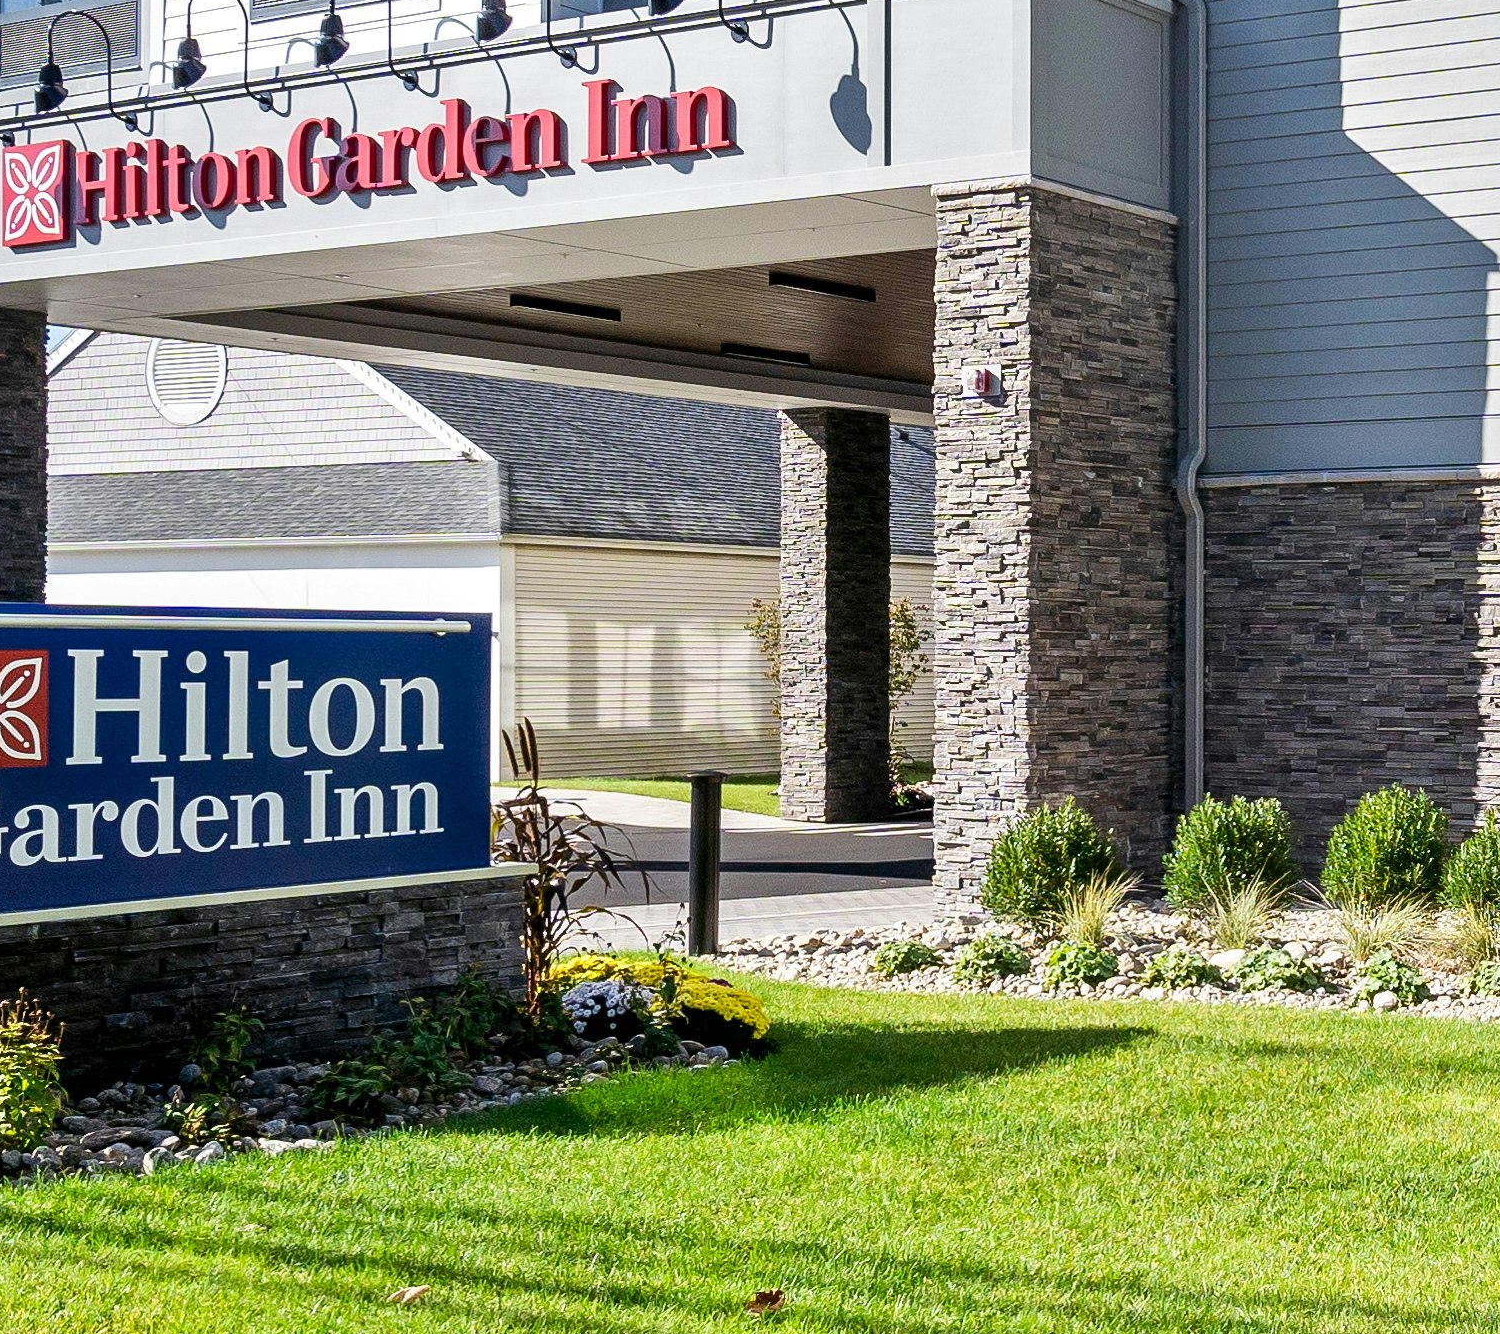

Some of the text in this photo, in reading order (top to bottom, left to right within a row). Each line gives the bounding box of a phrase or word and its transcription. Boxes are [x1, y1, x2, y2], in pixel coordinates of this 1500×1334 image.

[73, 79, 731, 226] Hilton Garden Inn
[65, 648, 445, 766] Hilton
[303, 769, 445, 844] Inn
